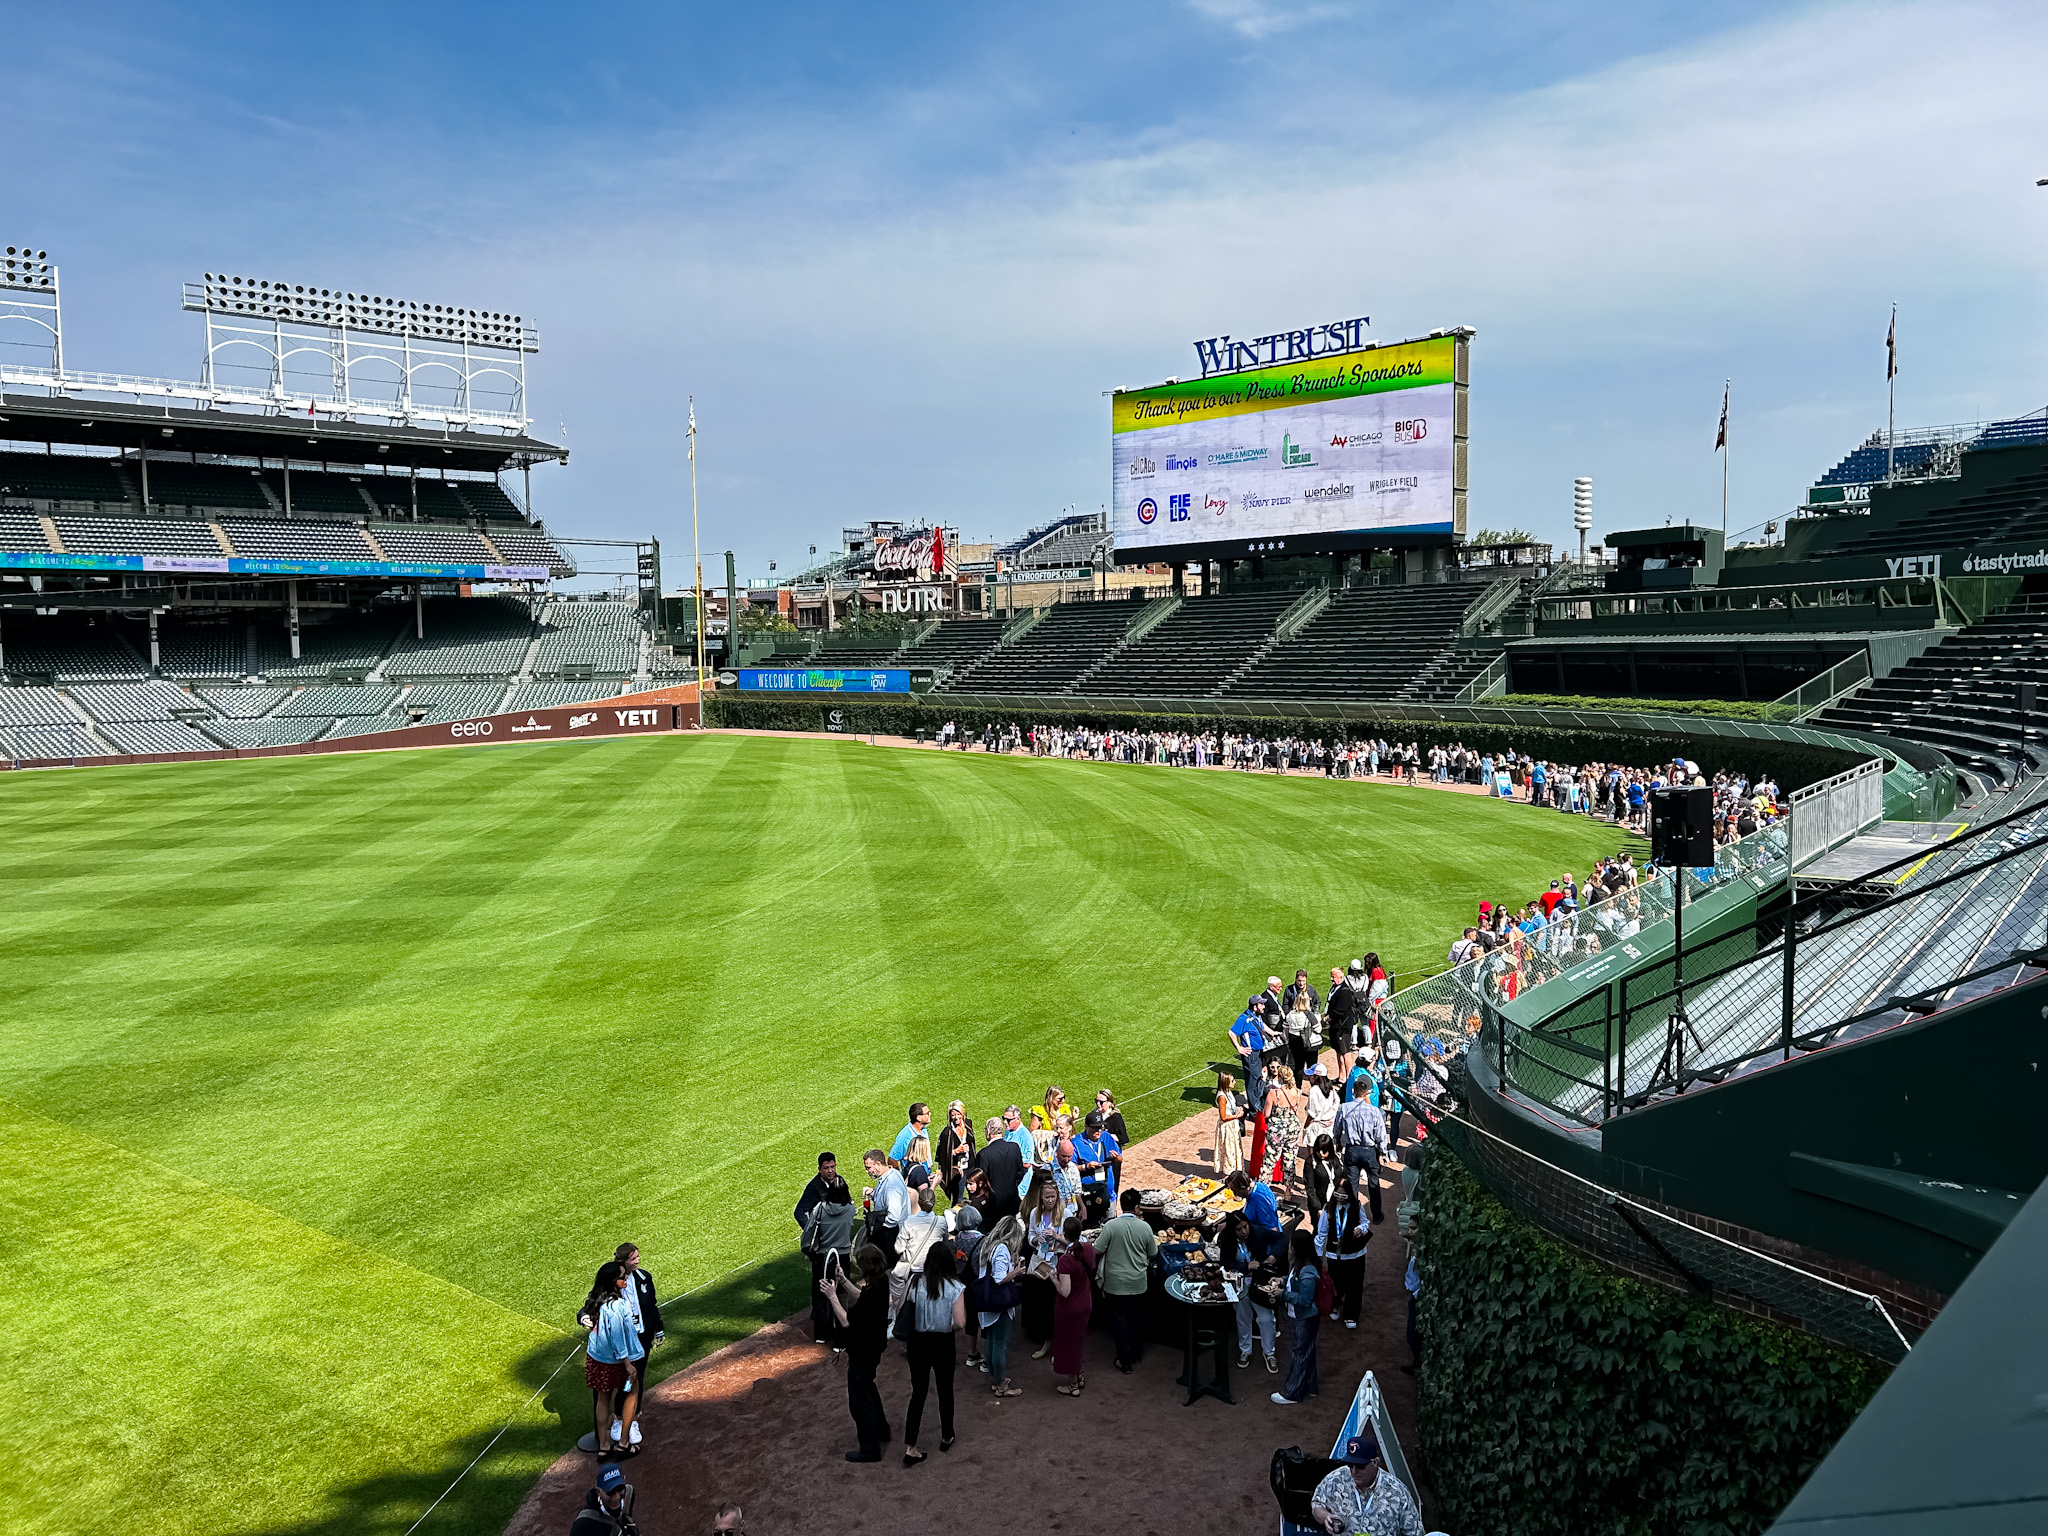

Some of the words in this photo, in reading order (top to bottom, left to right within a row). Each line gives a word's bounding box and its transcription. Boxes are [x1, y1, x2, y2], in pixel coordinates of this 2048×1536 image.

[1193, 316, 1370, 373] WINTRUST
[1134, 398, 1175, 420] Thank
[1177, 402, 1201, 420] you
[1202, 393, 1218, 409] to
[1218, 392, 1242, 405] our
[1246, 382, 1286, 402] Press
[1290, 373, 1345, 396] Brunch
[1350, 359, 1424, 386] Sponsors
[1395, 420, 1412, 432] BIG
[1349, 431, 1382, 443] CHICAGO
[1395, 431, 1412, 442] BUS
[1208, 452, 1234, 462] O'HARE
[1240, 447, 1268, 458] MIDWAY
[1289, 453, 1311, 464] CHICAGO
[1166, 456, 1198, 471] illinois
[1304, 482, 1350, 498] wendella
[1369, 479, 1398, 492] WRIGLEY
[1399, 476, 1418, 488] FIELD
[1249, 498, 1270, 509] NAVY
[1271, 496, 1291, 506] PIER
[874, 537, 936, 571] Coca-Cola
[245, 562, 271, 570] WELCOME
[1885, 554, 1941, 577] YETI
[757, 673, 794, 688] WELCOME
[797, 674, 807, 688] TO
[809, 672, 844, 691] Chicago
[615, 709, 659, 726] YETI
[450, 721, 493, 737] eero
